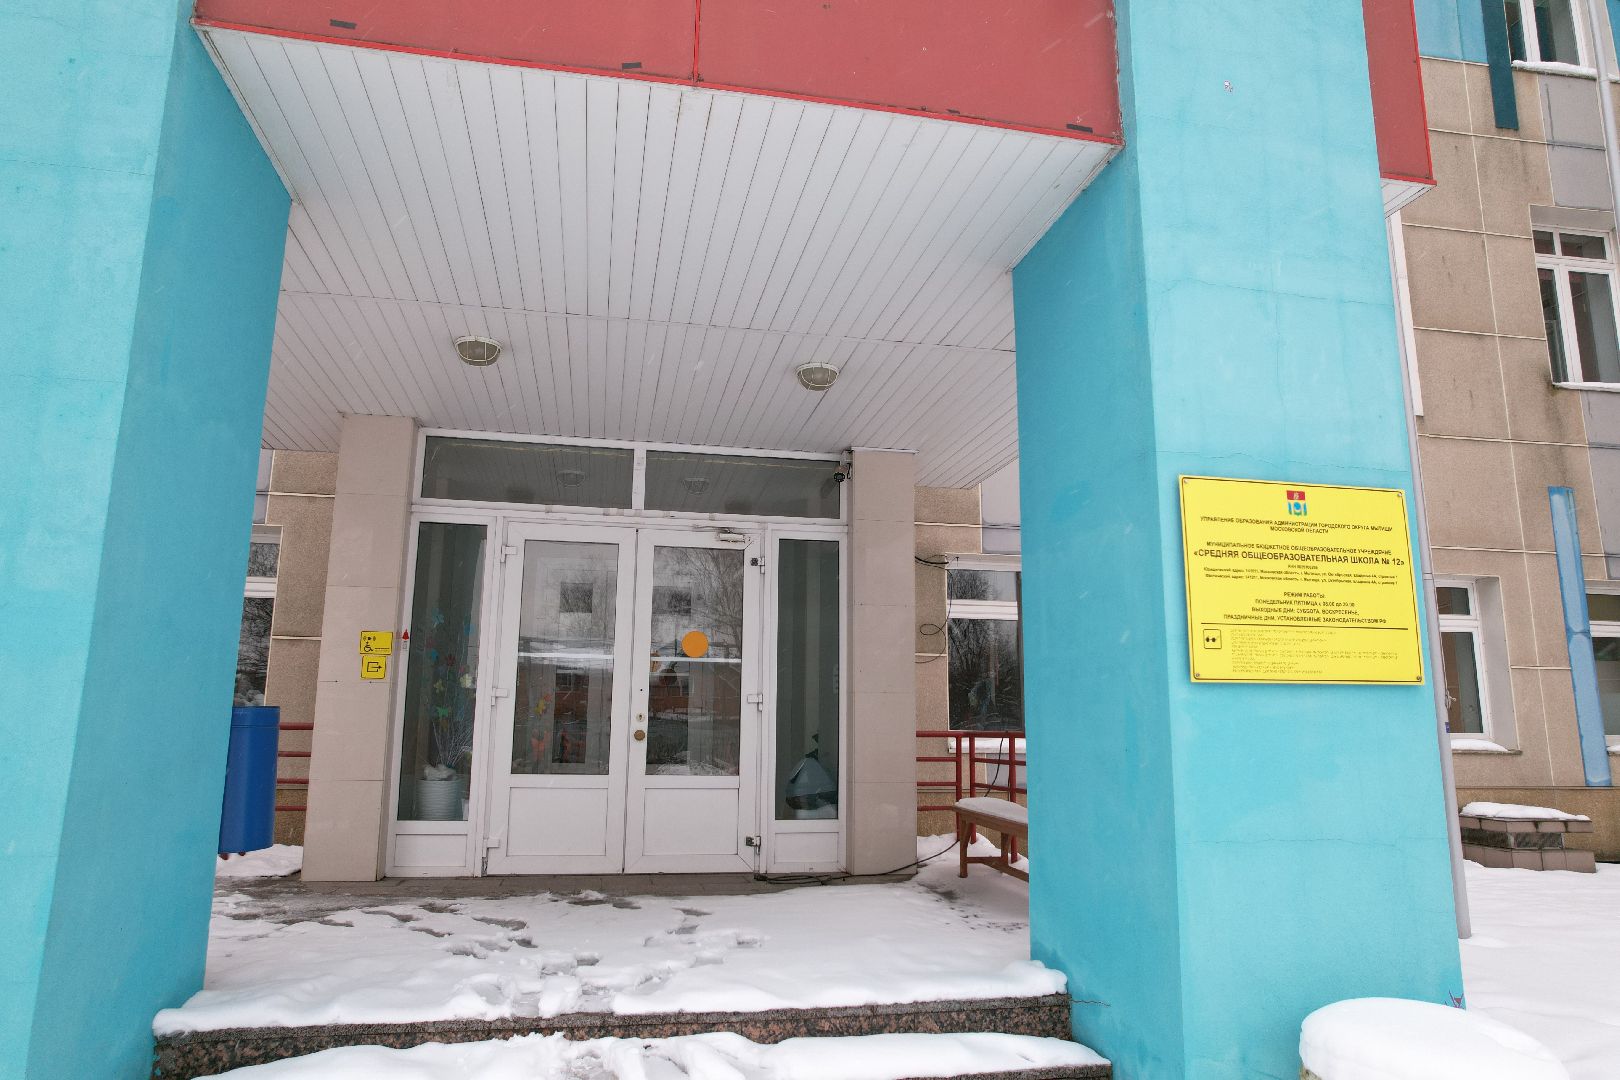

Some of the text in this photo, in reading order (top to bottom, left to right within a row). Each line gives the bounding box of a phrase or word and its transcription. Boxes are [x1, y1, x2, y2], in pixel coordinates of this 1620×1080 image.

[1291, 546, 1356, 554] ОБЩЕОБРАЗОВАТЕЛЬНОЕ
[1194, 549, 1240, 558] «СРЕДНЯЯ
[1242, 551, 1348, 563] ОБЩЕОБРАЗОВАТЕЛЬНАЯ
[1350, 556, 1380, 564] ШКОЛА
